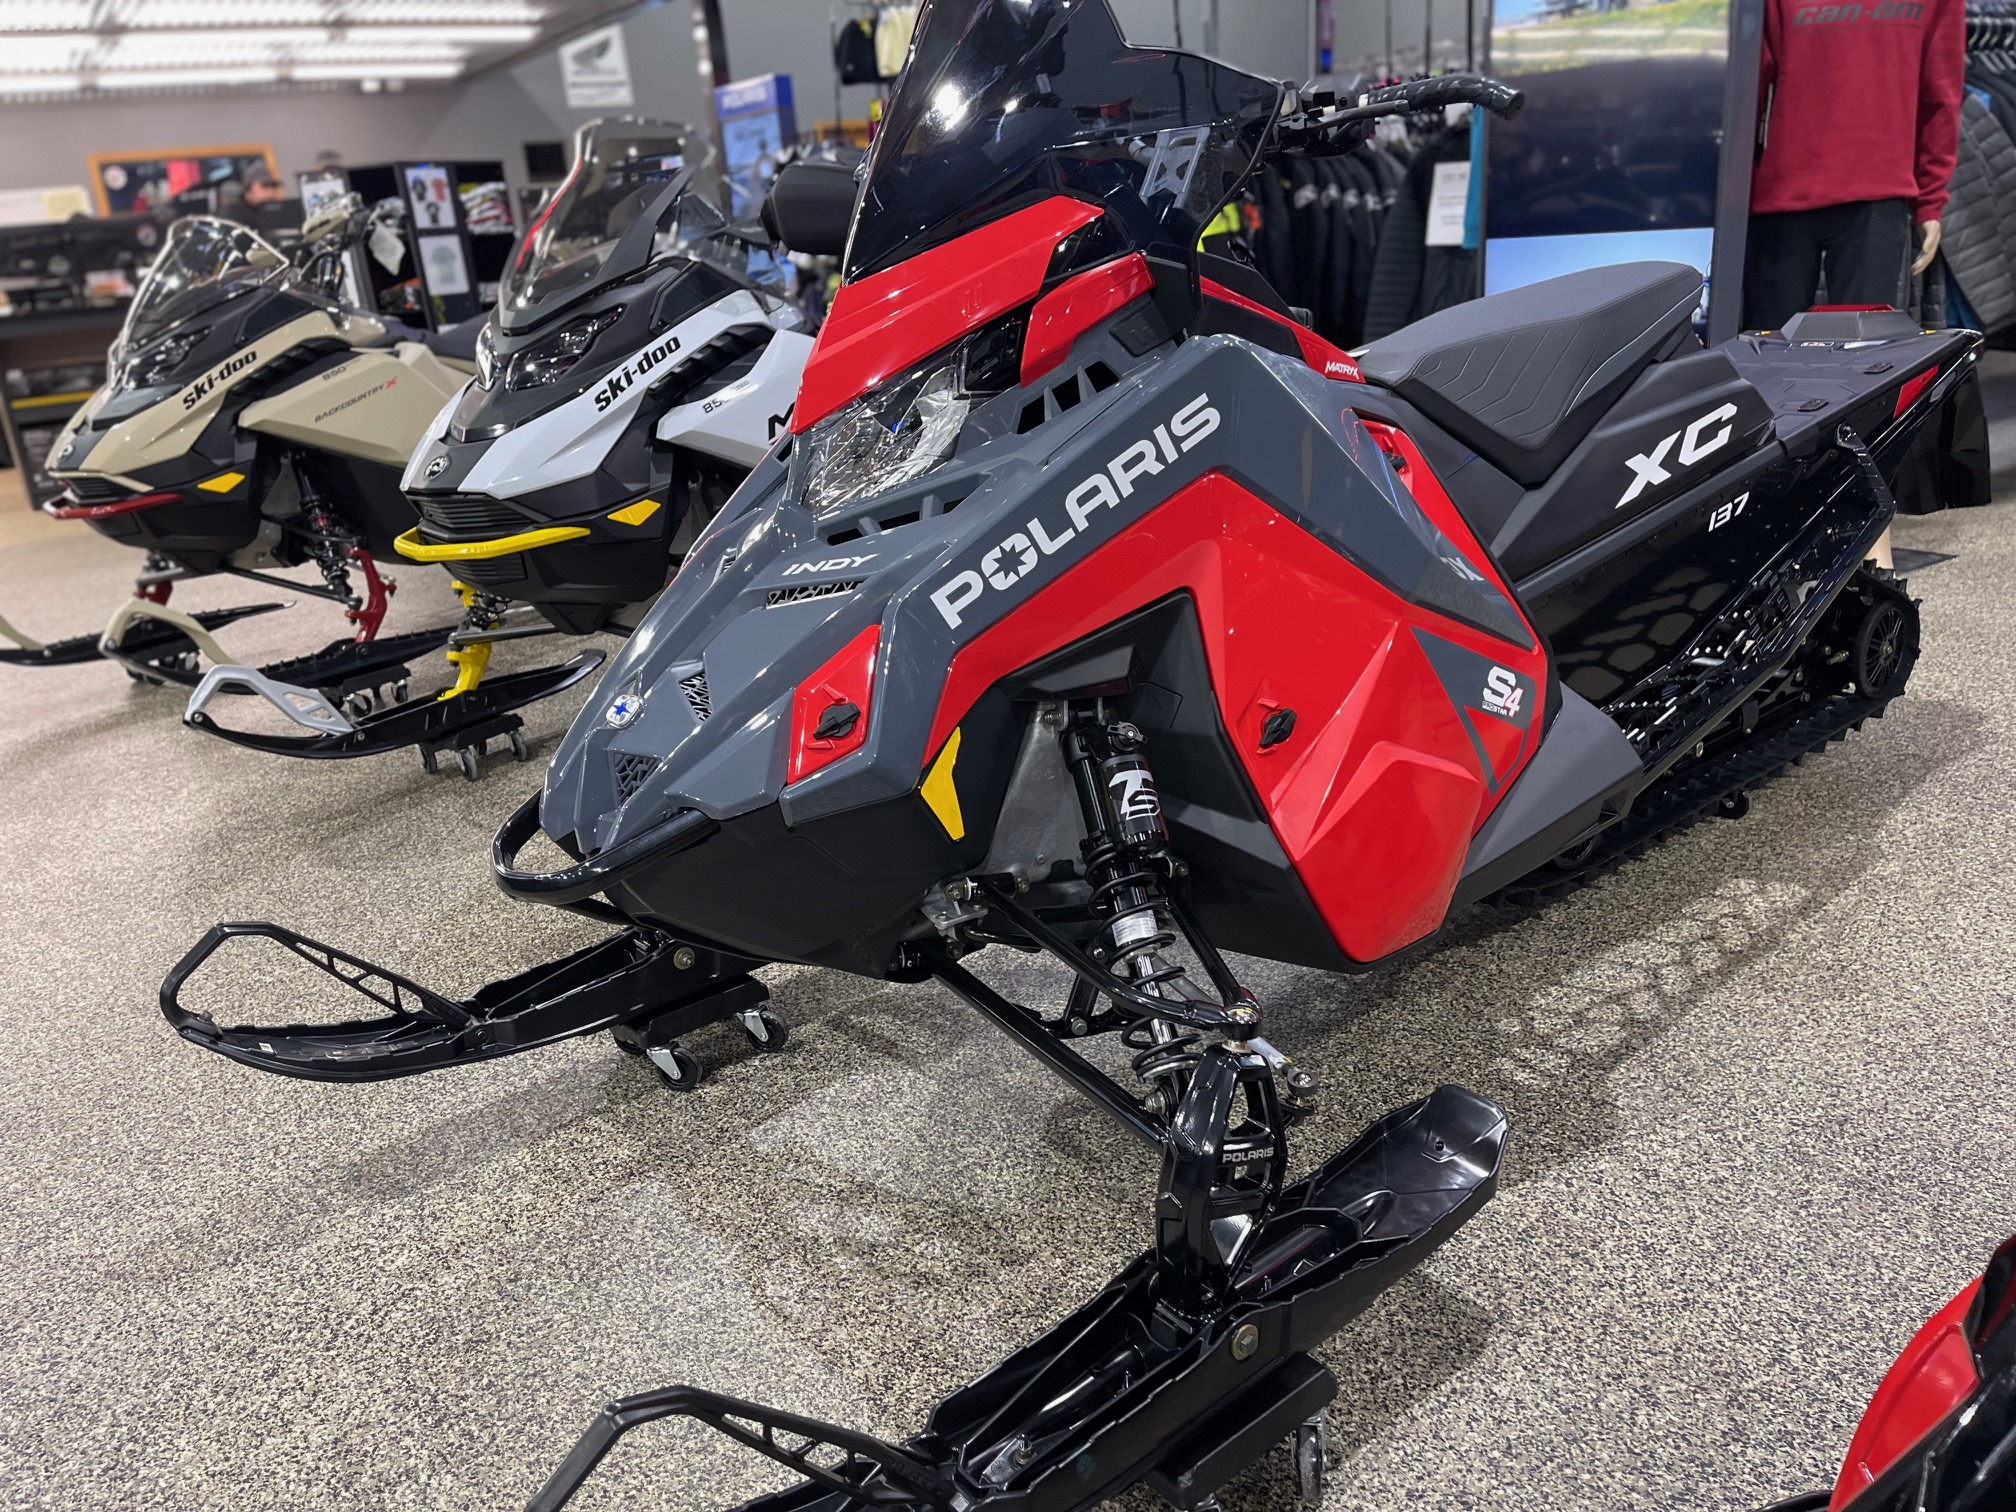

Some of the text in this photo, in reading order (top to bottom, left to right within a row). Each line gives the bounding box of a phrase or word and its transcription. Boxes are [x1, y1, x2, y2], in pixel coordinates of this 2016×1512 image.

[322, 365, 347, 381] 850
[314, 376, 398, 423] BACKCOUNTRY X
[1615, 402, 1738, 509] XC
[929, 392, 1221, 630] POLARIS
[1708, 491, 1750, 533] 137
[781, 552, 881, 576] INDY
[1222, 1146, 1275, 1164] POLARIS
